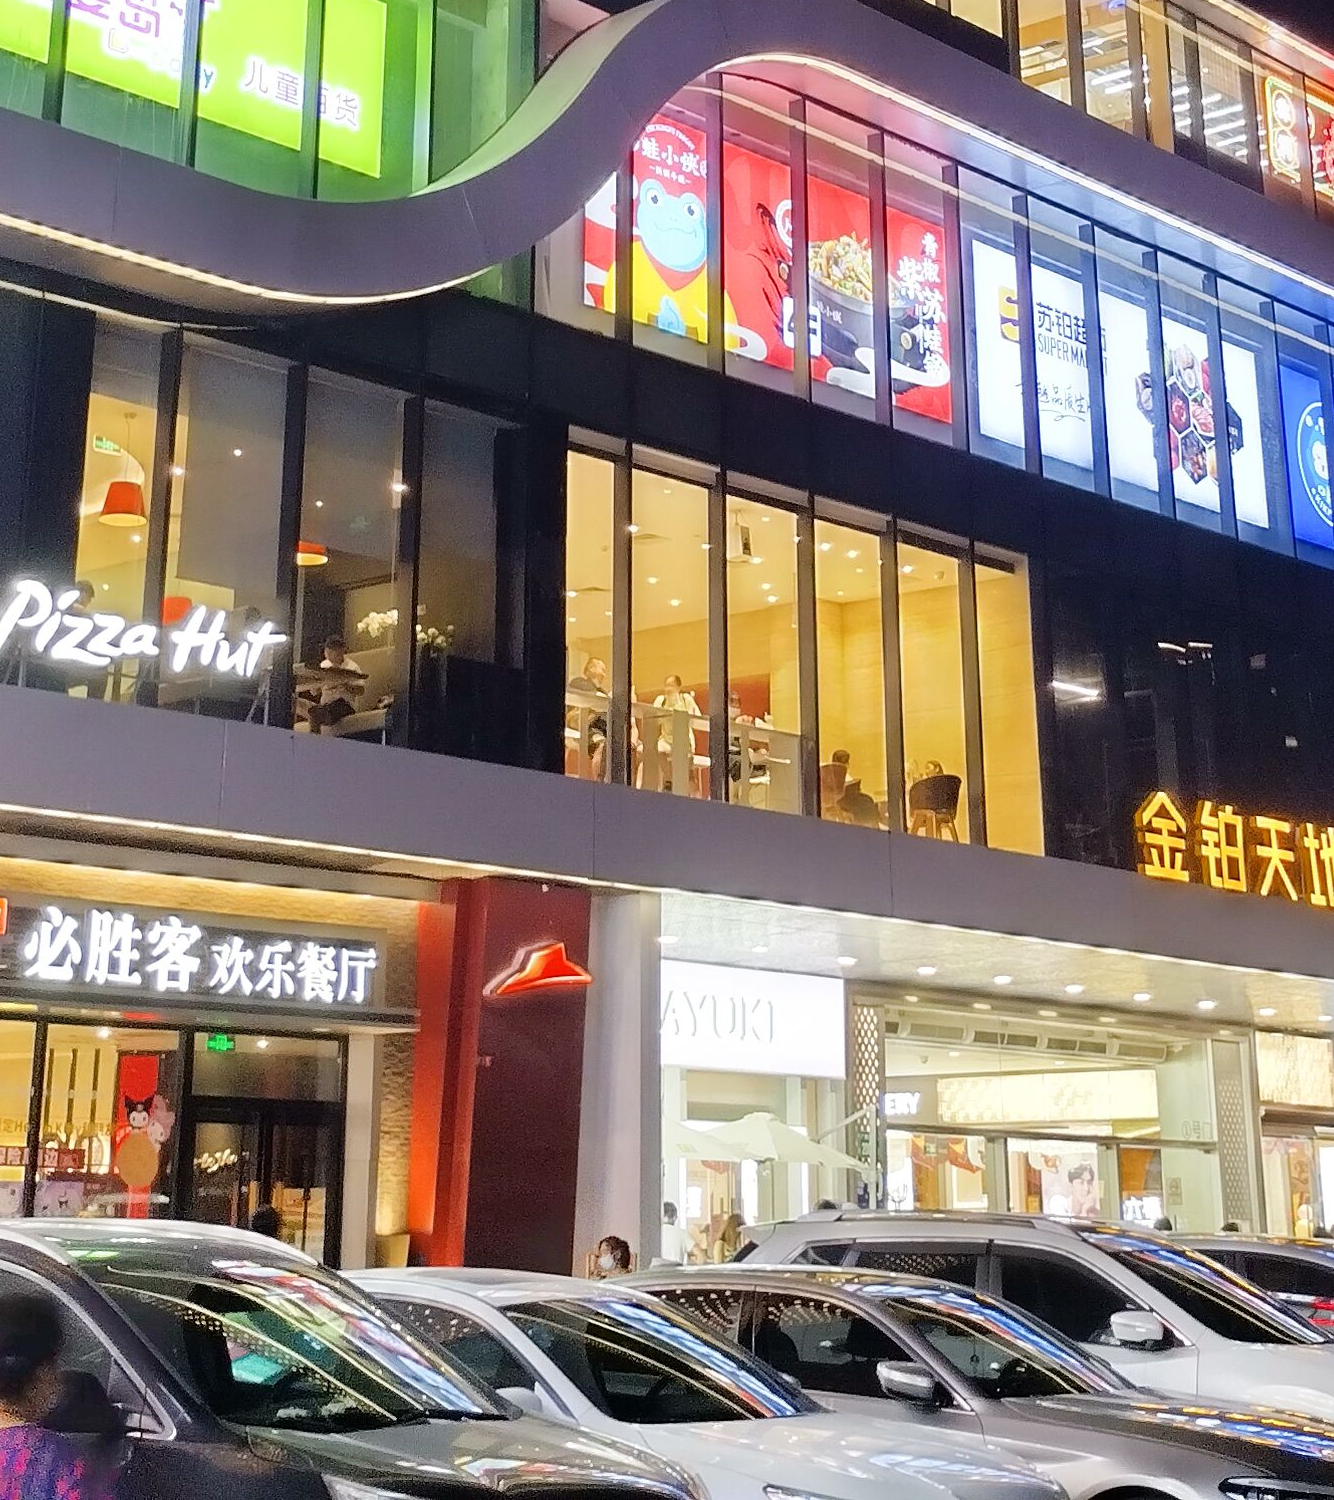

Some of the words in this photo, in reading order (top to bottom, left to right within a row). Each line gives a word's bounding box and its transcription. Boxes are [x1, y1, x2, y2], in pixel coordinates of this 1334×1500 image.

[1037, 333, 1070, 362] SUPER
[171, 604, 287, 678] Hut
[23, 905, 202, 992] 必胜客
[208, 936, 376, 1005] 欢乐餐厅
